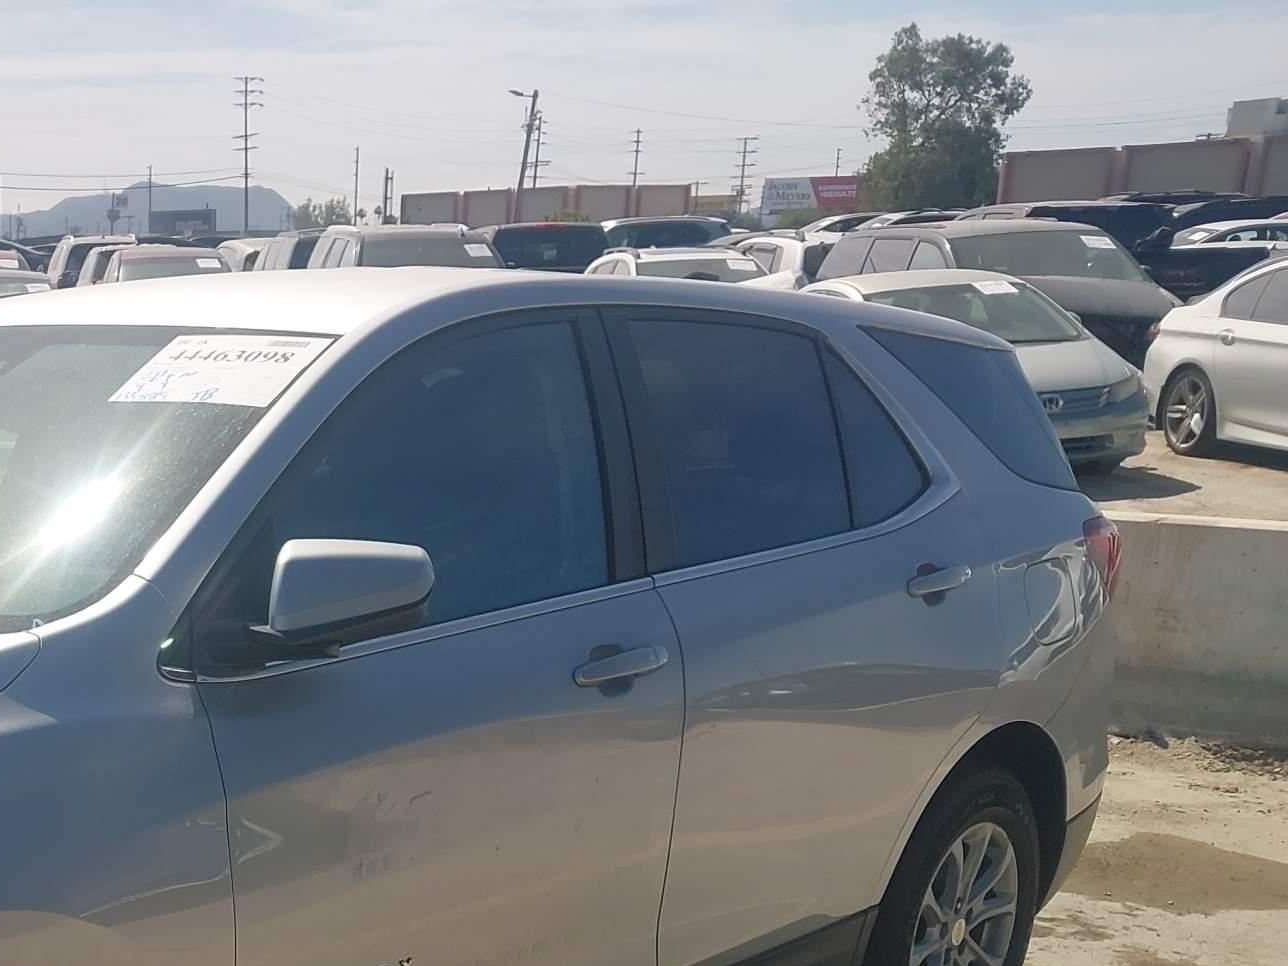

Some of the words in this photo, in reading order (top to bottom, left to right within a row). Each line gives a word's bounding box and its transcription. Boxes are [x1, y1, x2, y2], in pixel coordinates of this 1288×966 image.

[768, 181, 800, 191] JACOBY
[776, 191, 810, 201] MEYERS
[168, 349, 296, 364] 44463098
